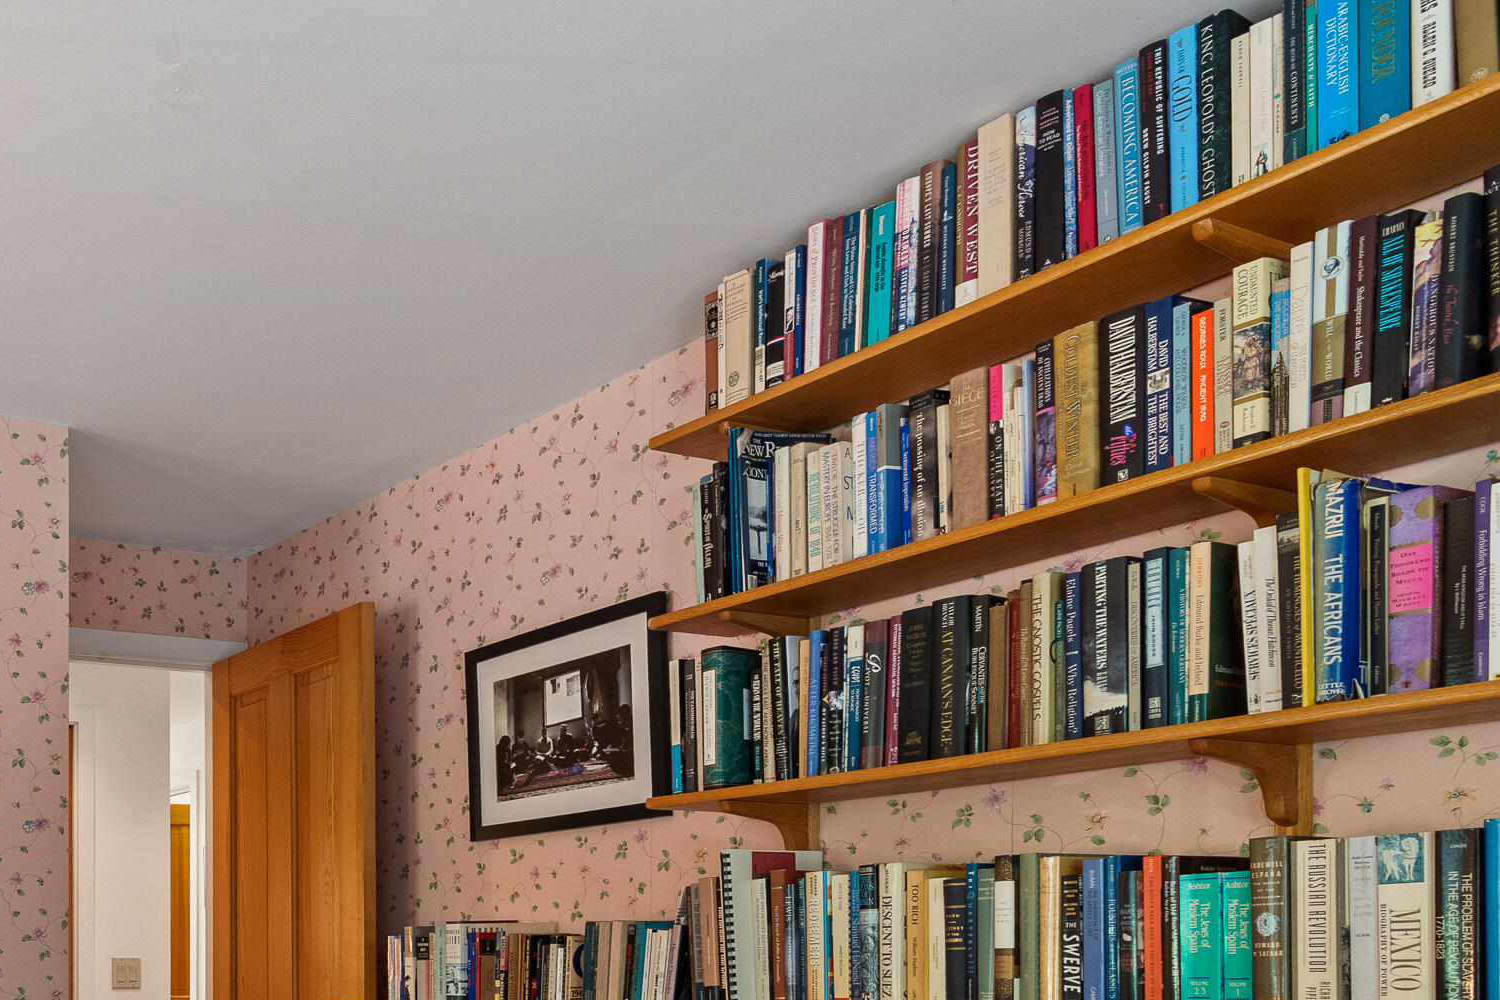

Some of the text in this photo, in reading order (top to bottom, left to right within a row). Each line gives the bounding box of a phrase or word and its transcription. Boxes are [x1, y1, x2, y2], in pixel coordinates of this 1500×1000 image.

[1325, 18, 1338, 87] DICTIONARY
[1422, 22, 1437, 49] ALLEN
[1154, 47, 1164, 155] THIS REPUBLIC OF SUFFERING
[1171, 74, 1193, 123] GOLD
[1422, 58, 1437, 90] GUELZO
[1142, 128, 1150, 148] DREW
[1200, 24, 1216, 198] KING LEOPOLD'S GHOST
[1018, 115, 1035, 218] American Heroes
[1121, 77, 1141, 223] BECOMING AMERICA
[965, 146, 980, 274] DRIVEN WEST
[1236, 268, 1250, 321] COURAGE
[1249, 264, 1259, 316] UNDAUNTED
[1379, 265, 1403, 333] SHAKESPEARE
[1148, 316, 1158, 372] HALBERSTAM
[1159, 340, 1169, 368] DAVID
[1199, 316, 1208, 350] GEORGES
[1219, 308, 1228, 343] FORSTER
[1064, 334, 1081, 462] COLDEST WINTER
[1109, 315, 1137, 425] DAVID HALBERSTAM
[1148, 395, 1158, 466] THE BRIGHTEST
[1159, 391, 1169, 455] THE BEST AND
[913, 412, 927, 538] The passing of an illusion
[995, 435, 1004, 510] ON THE STATE
[808, 472, 821, 558] REVOLUTIONS OF 1848
[868, 473, 877, 535] TRANSFORMED
[1322, 482, 1345, 666] MAZRUI THE AFRICANS
[1477, 529, 1488, 568] Forbidding
[1065, 579, 1077, 643] Elaine Pagels
[1195, 594, 1204, 625] Edmund
[1476, 568, 1487, 593] Wrong
[1477, 602, 1487, 621] Islam
[977, 646, 987, 686] CERVANTES
[1032, 594, 1043, 722] THE GNOSTIC GOSPELS
[809, 678, 820, 756] AFTER KHOMEINI
[941, 630, 954, 748] AT CANAAN'S EDGE
[1066, 663, 1079, 735] Why Religion?
[784, 895, 792, 922] LEWIS
[911, 884, 920, 926] TOO RICH
[1187, 882, 1211, 890] Ashtor
[1225, 881, 1249, 889] Ashtor
[1308, 843, 1327, 973] THE RUSSIAN REVOLUTION
[809, 899, 820, 967] REDEEMERS
[881, 895, 893, 999] DESCENT TO SUEZ
[1186, 899, 1200, 953] Moslem Spain
[1200, 903, 1211, 948] The Jews of
[1224, 899, 1239, 955] Moslem Spain
[1238, 903, 1250, 949] The Jews of
[1380, 903, 1388, 952] BIOGRAPHY
[1389, 908, 1422, 992] MEXICO
[1436, 915, 1445, 960] 1770-1823
[1448, 871, 1459, 1000] IN THE AGE OF REVOLUTION
[1462, 872, 1473, 1000] THE PROBLEM OF SLAVERY
[1062, 934, 1082, 994] SWERVE
[1381, 954, 1388, 965] OF
